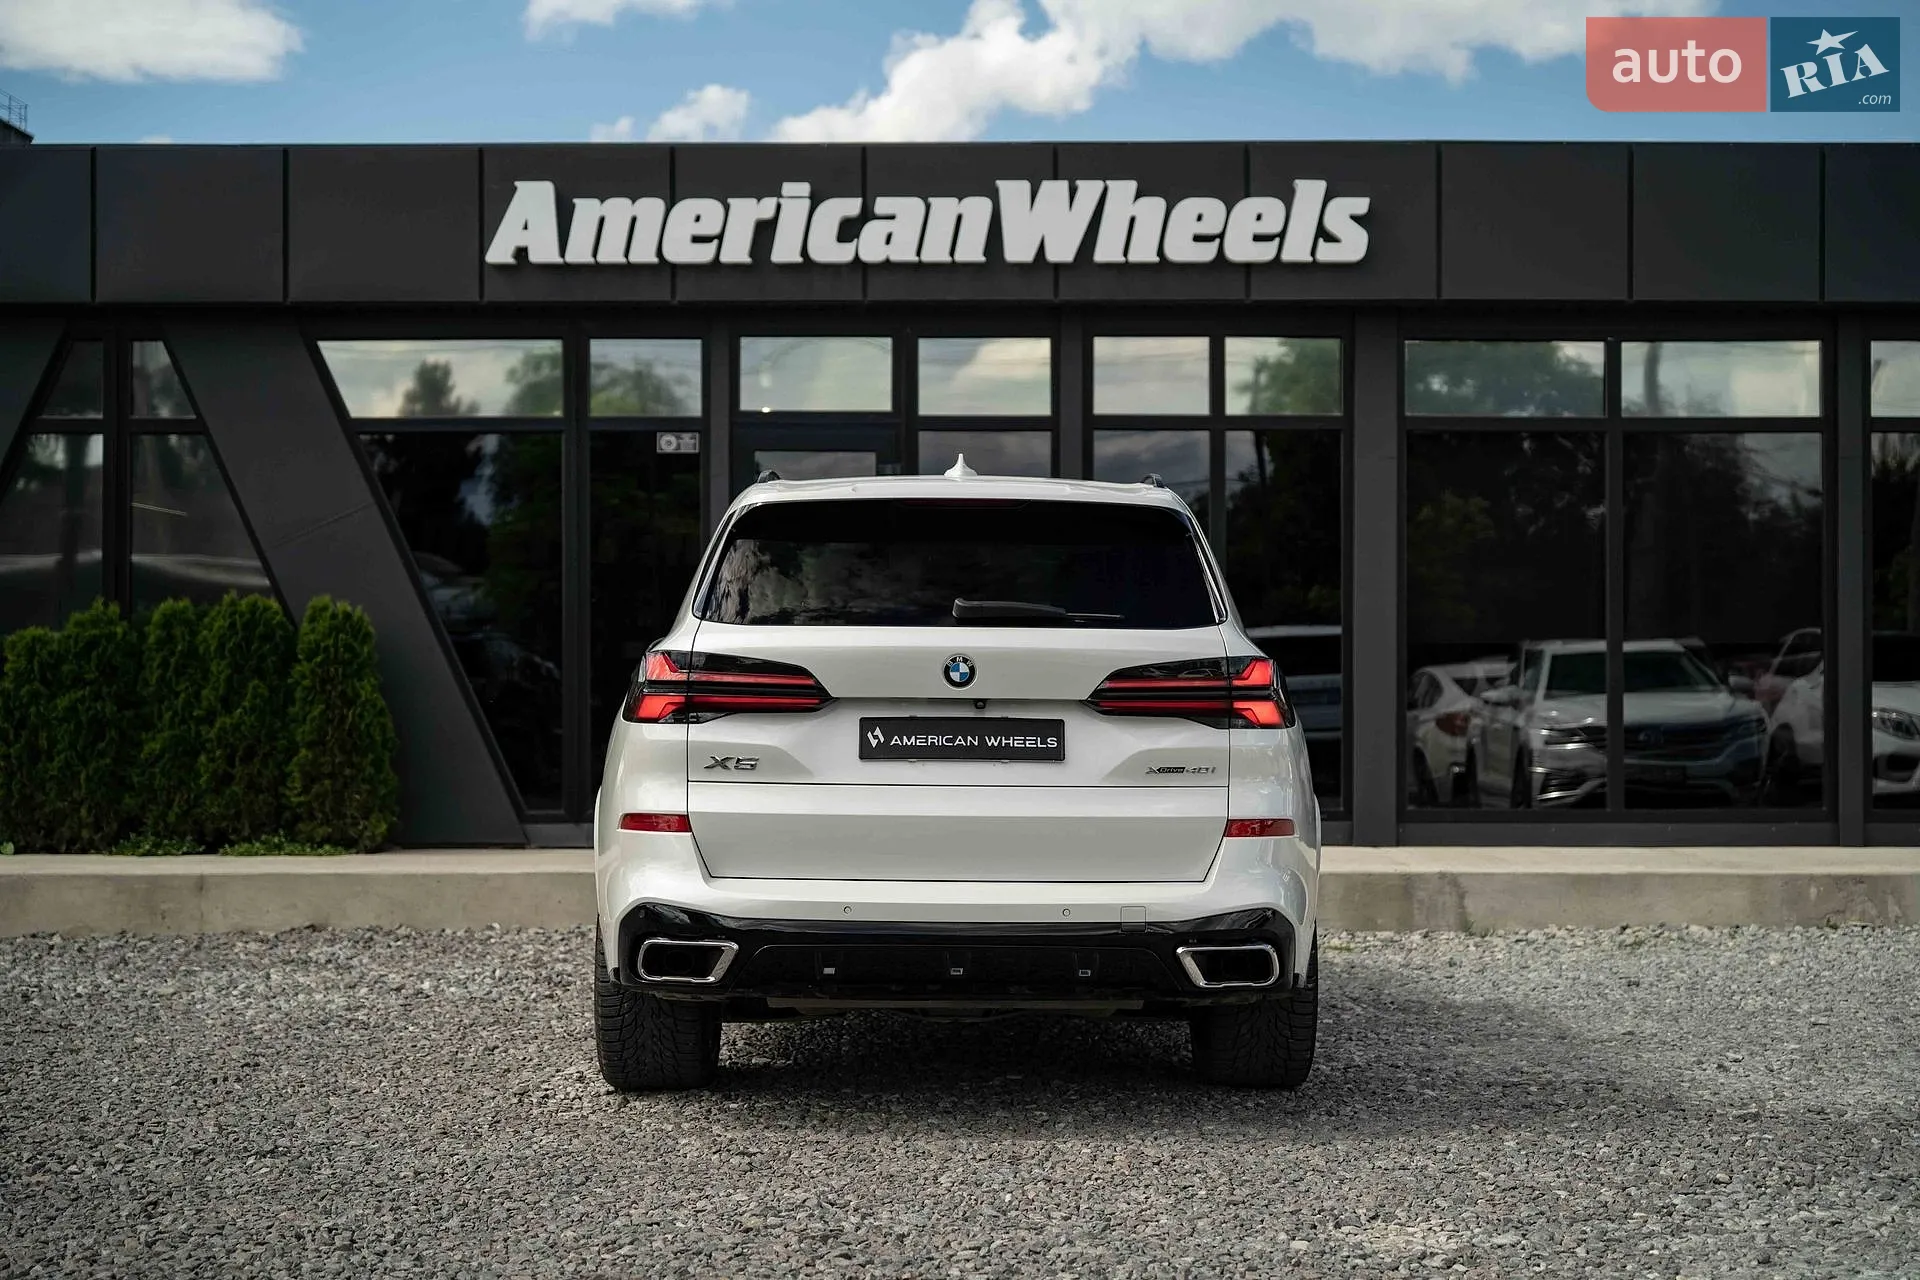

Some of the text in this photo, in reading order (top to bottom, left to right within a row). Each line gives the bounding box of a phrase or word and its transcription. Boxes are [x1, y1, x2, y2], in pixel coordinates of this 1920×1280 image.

[890, 735, 1058, 748] AMERICAN WHEELS
[703, 755, 759, 771] X5
